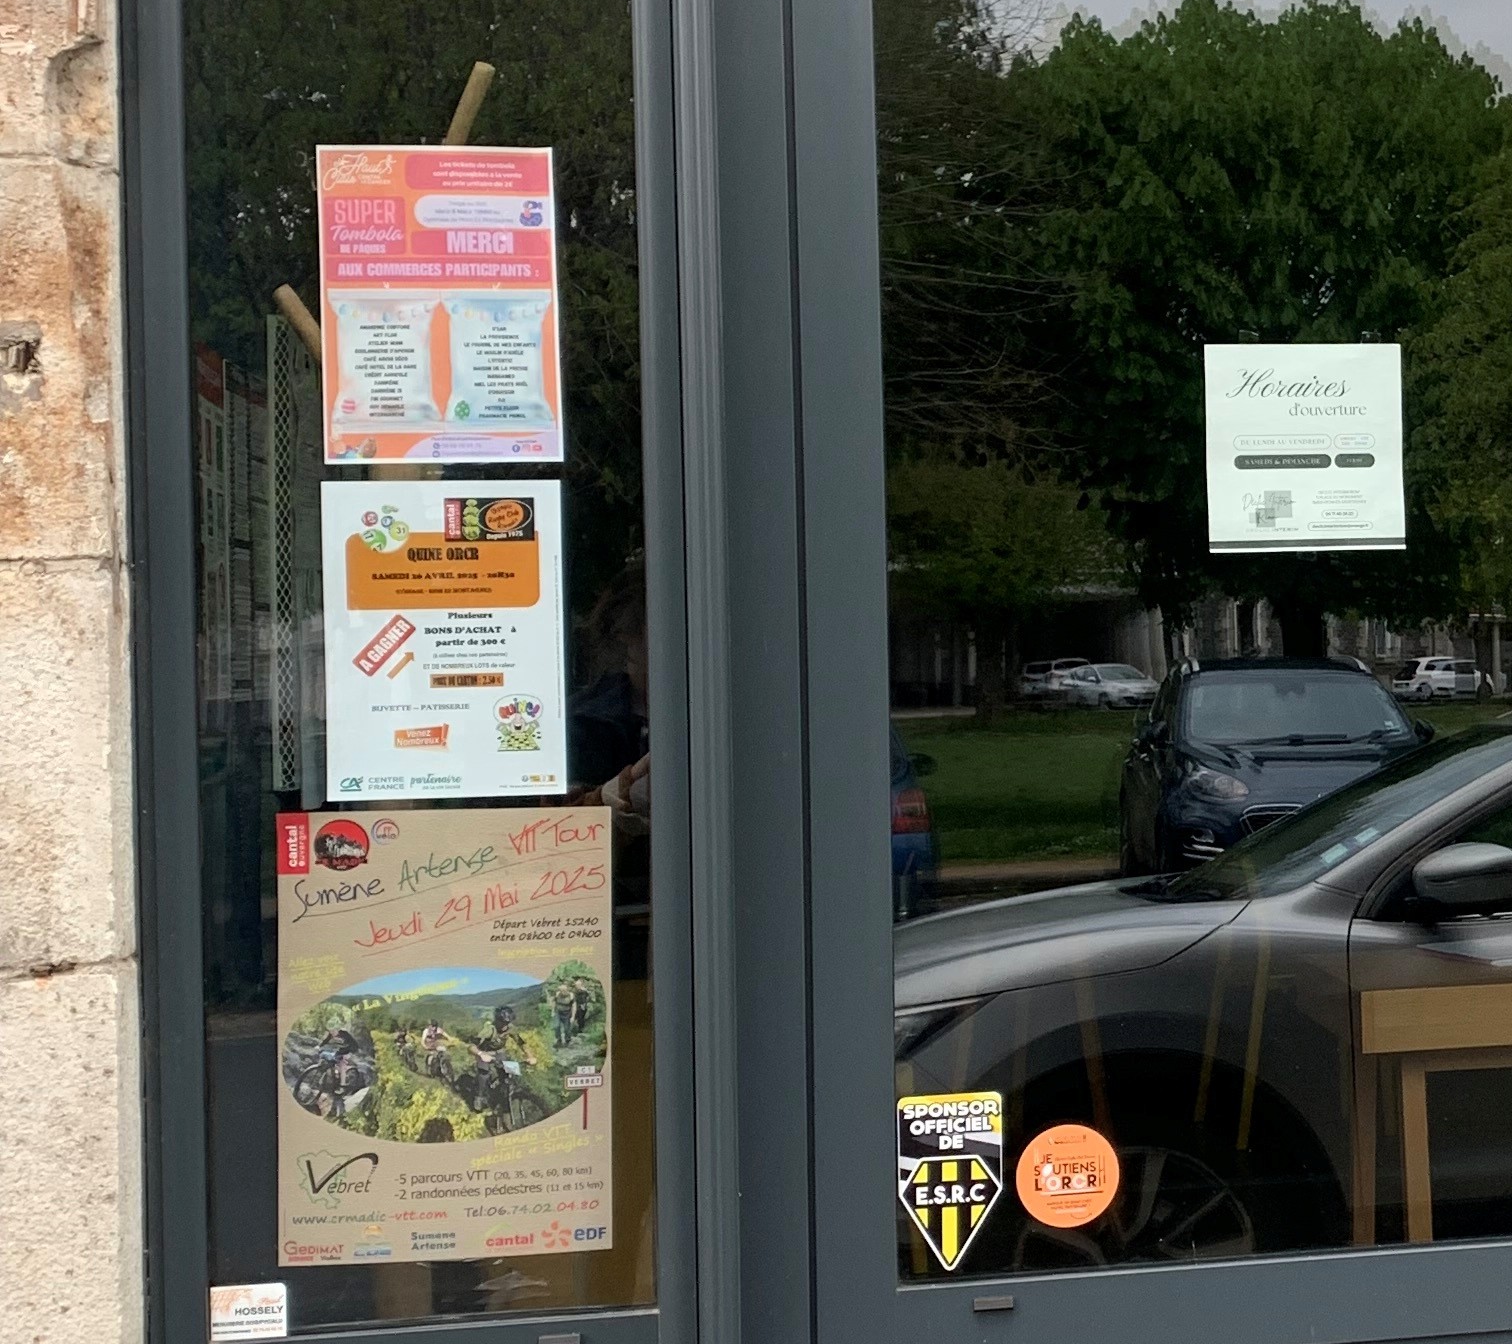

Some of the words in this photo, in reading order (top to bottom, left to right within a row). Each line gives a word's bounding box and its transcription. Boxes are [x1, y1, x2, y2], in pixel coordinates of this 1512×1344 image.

[334, 199, 396, 224] SUPER
[330, 225, 404, 241] Tombola
[340, 244, 350, 253] DE
[447, 231, 514, 254] MERCI
[338, 263, 362, 276] AUX
[367, 263, 441, 276] COMMERCES
[445, 263, 531, 277] PARTICIPANTS
[1225, 368, 1350, 398] Horaires
[1289, 403, 1367, 417] d'ouverture
[446, 504, 456, 535] cantal
[407, 547, 442, 562] QUINE
[446, 547, 479, 561] ORCR
[448, 612, 493, 620] Plusieurs
[424, 627, 453, 635] BONS
[454, 626, 502, 634] D'ACHAT
[358, 658, 373, 672] A
[366, 619, 411, 664] GAGNER
[435, 638, 465, 647] partir
[467, 638, 479, 646] de
[371, 704, 411, 712] BUVETTE
[420, 703, 470, 711] PATISSERIE
[397, 737, 440, 746] Nombreux
[406, 730, 432, 738] Venez
[410, 773, 461, 790] partenaire
[285, 825, 298, 867] cantal
[292, 878, 385, 923] Sumène
[397, 846, 498, 892] Artense
[508, 818, 550, 856] VTT
[541, 815, 605, 847] Tour
[354, 912, 423, 947] Jeudi
[434, 895, 472, 929] 29
[484, 883, 519, 914] Mai
[530, 864, 606, 901] 2025
[493, 918, 528, 931] Départ
[530, 918, 561, 927] Vebret
[565, 917, 599, 926] 15240
[489, 932, 515, 942] entre
[555, 931, 565, 939] et
[903, 1099, 999, 1120] SPONSOR
[909, 1116, 992, 1136] OFFICIEL
[494, 1132, 537, 1147] Rando
[543, 1124, 571, 1136] VTT
[938, 1134, 964, 1150] DE
[544, 1135, 590, 1154] Singles
[1040, 1154, 1053, 1164] JE
[306, 1152, 379, 1194] Vebret
[411, 1173, 463, 1186] parcours
[466, 1170, 490, 1181] VTT
[562, 1168, 573, 1176] 80
[1034, 1161, 1096, 1177] SOUTIENS
[411, 1186, 480, 1200] randonnées
[484, 1183, 542, 1201] pédestres
[562, 1183, 571, 1191] et
[575, 1182, 585, 1191] 15
[915, 1183, 985, 1206] E.S.R.C
[486, 1233, 534, 1247] cantal
[235, 1305, 284, 1316] HOSSELY
